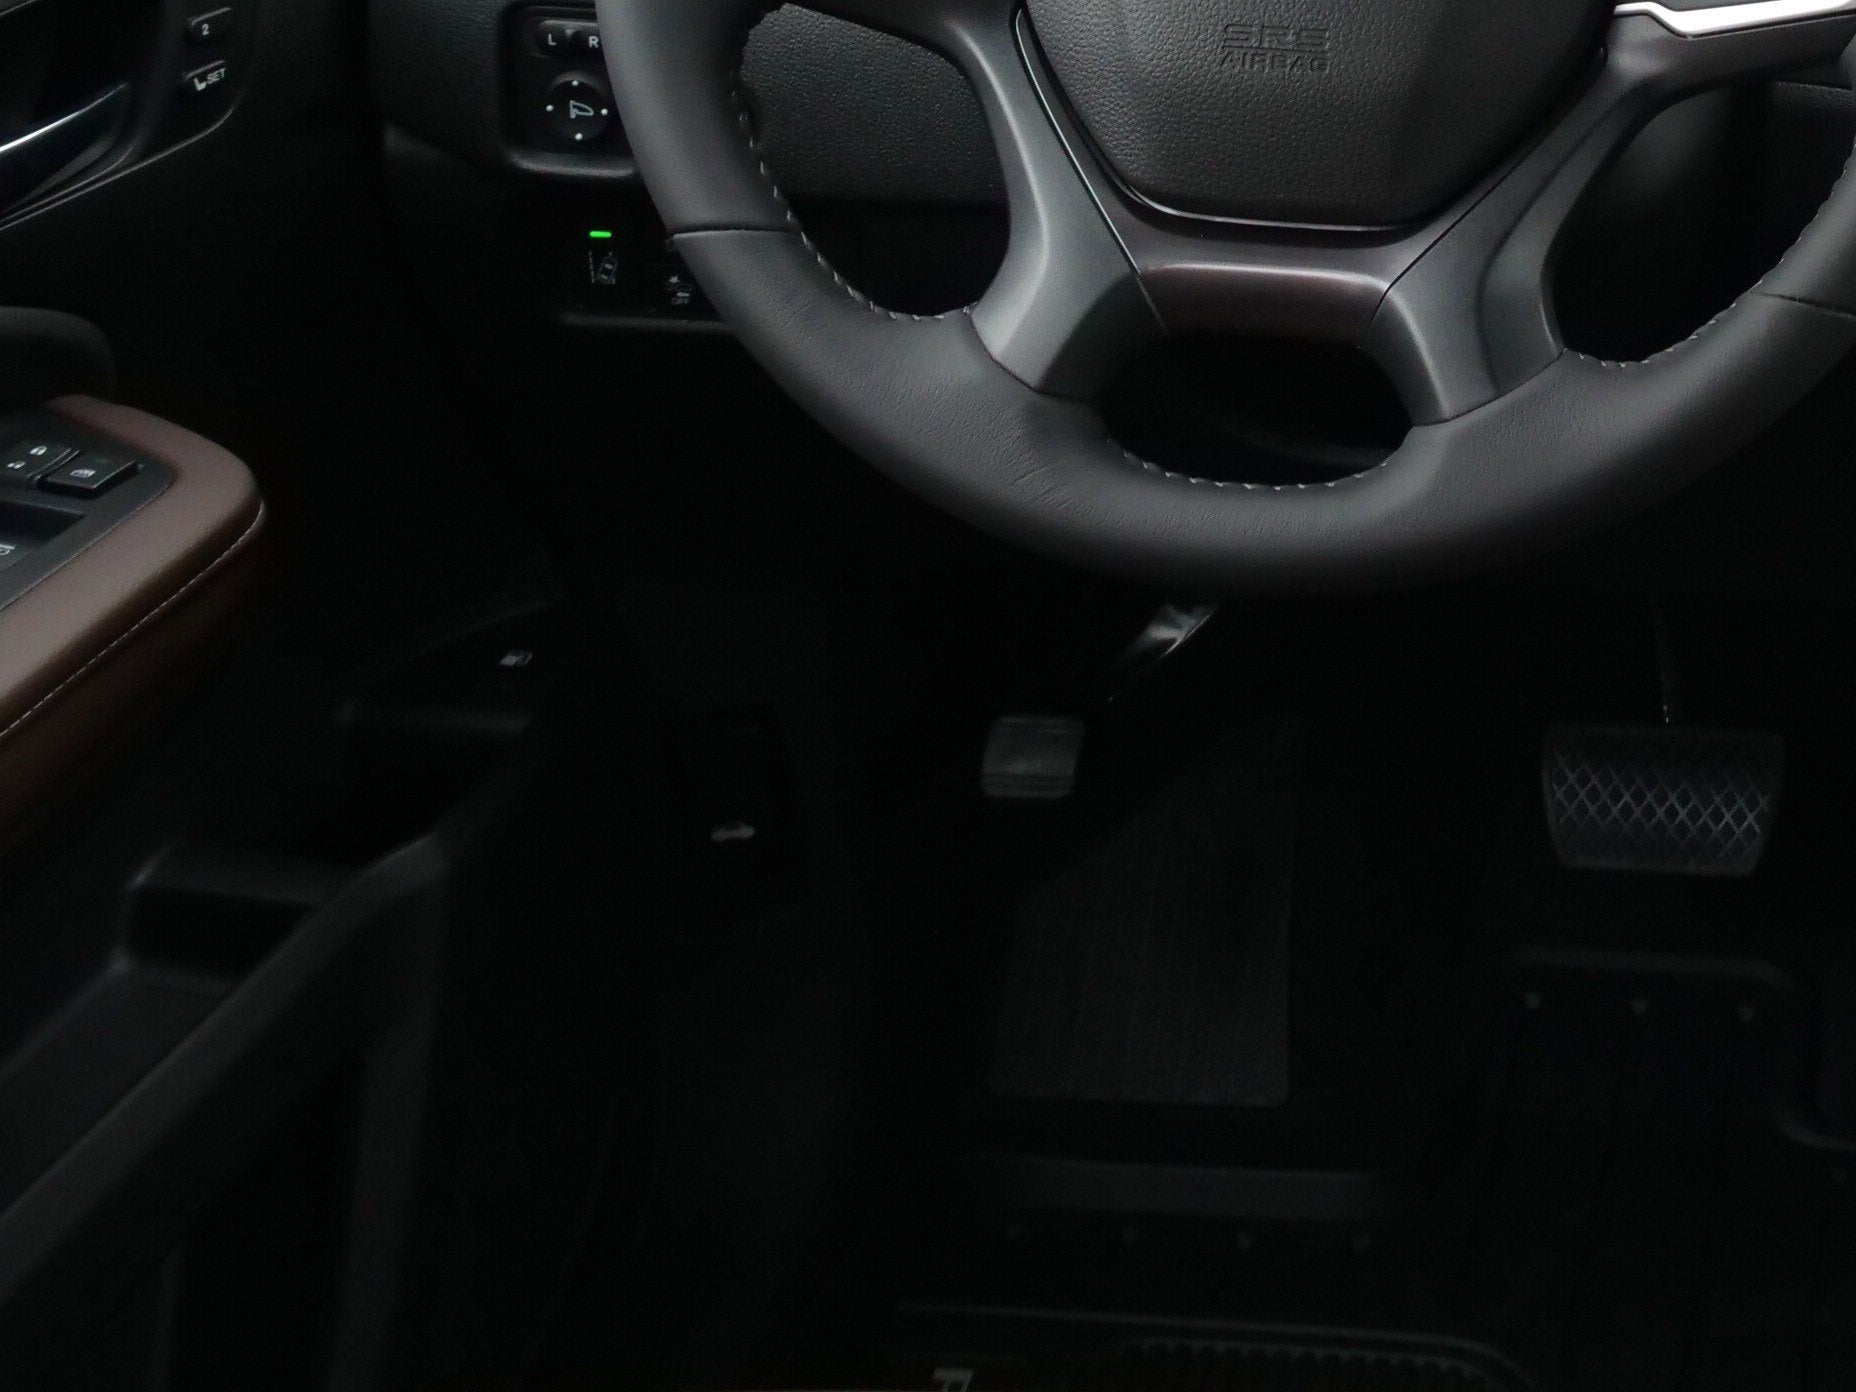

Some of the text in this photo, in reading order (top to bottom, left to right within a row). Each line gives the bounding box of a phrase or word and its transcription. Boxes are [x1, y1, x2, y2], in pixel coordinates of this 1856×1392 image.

[202, 23, 210, 35] 2
[548, 33, 599, 48] L R
[207, 68, 226, 85] SET
